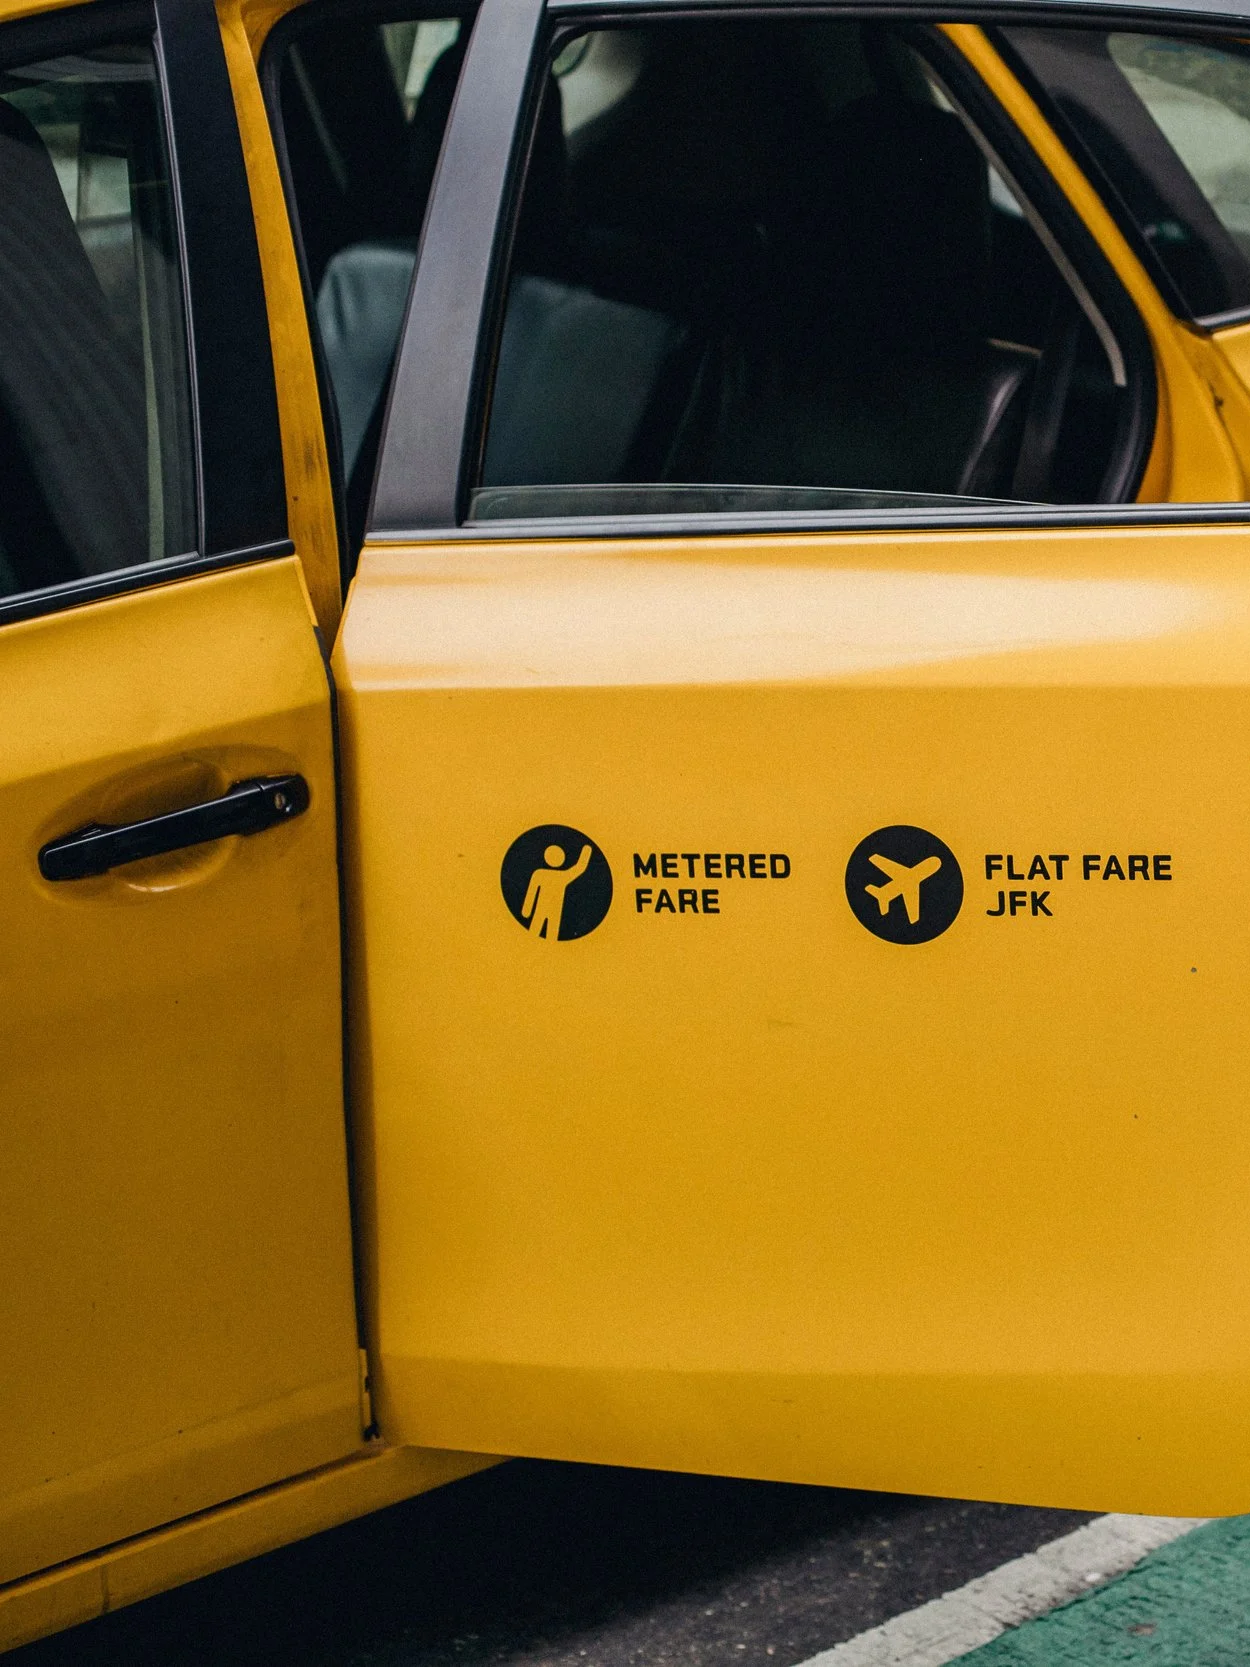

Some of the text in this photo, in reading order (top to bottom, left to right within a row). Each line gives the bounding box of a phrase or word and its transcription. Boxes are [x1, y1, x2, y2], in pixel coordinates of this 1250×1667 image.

[633, 853, 791, 879] METERED
[984, 854, 1173, 881] FLAT FARE
[635, 888, 721, 914] FARE
[986, 890, 1054, 917] JFK
